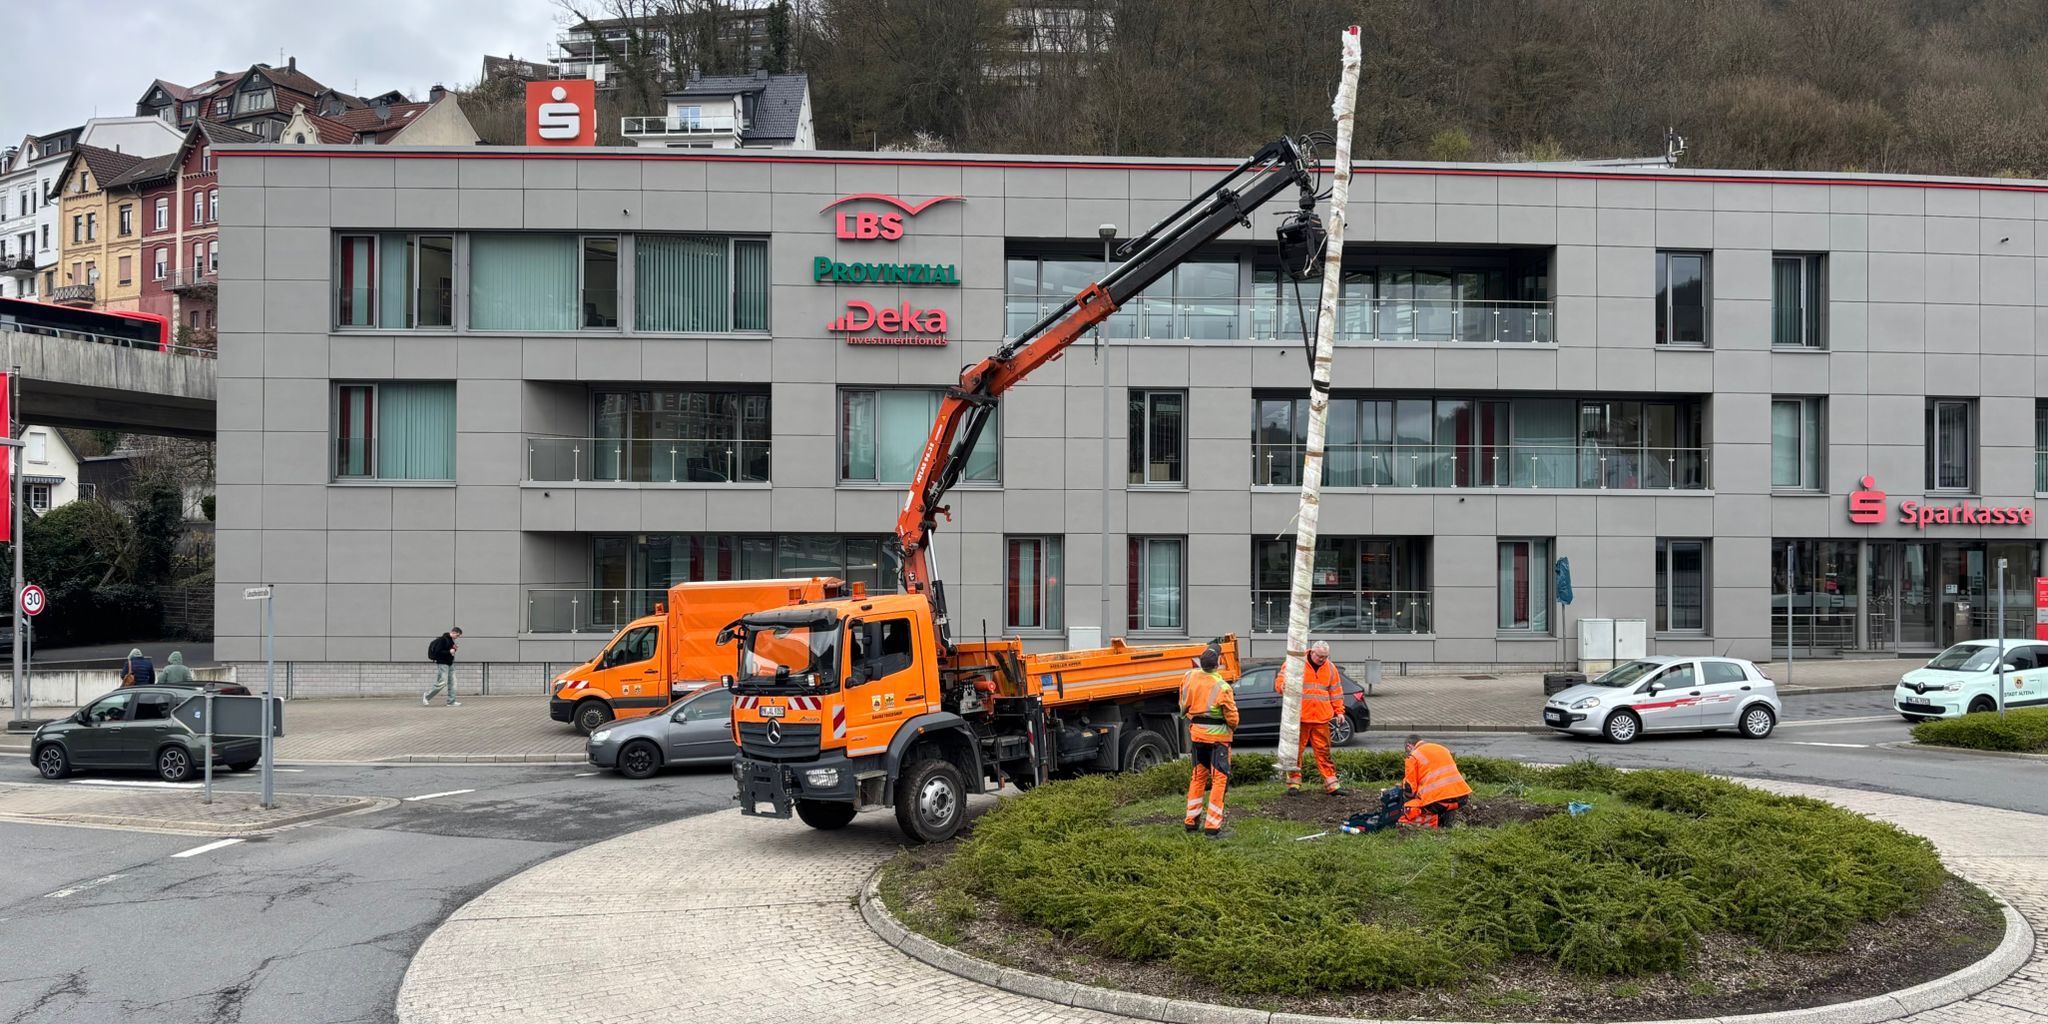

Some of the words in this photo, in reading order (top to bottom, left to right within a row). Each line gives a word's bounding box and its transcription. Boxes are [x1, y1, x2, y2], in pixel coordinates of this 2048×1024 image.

[836, 211, 904, 241] LBS
[846, 300, 948, 333] Deka
[916, 461, 927, 484] ATLAS
[1900, 500, 2034, 530] Sparkasse
[26, 592, 40, 606] 30
